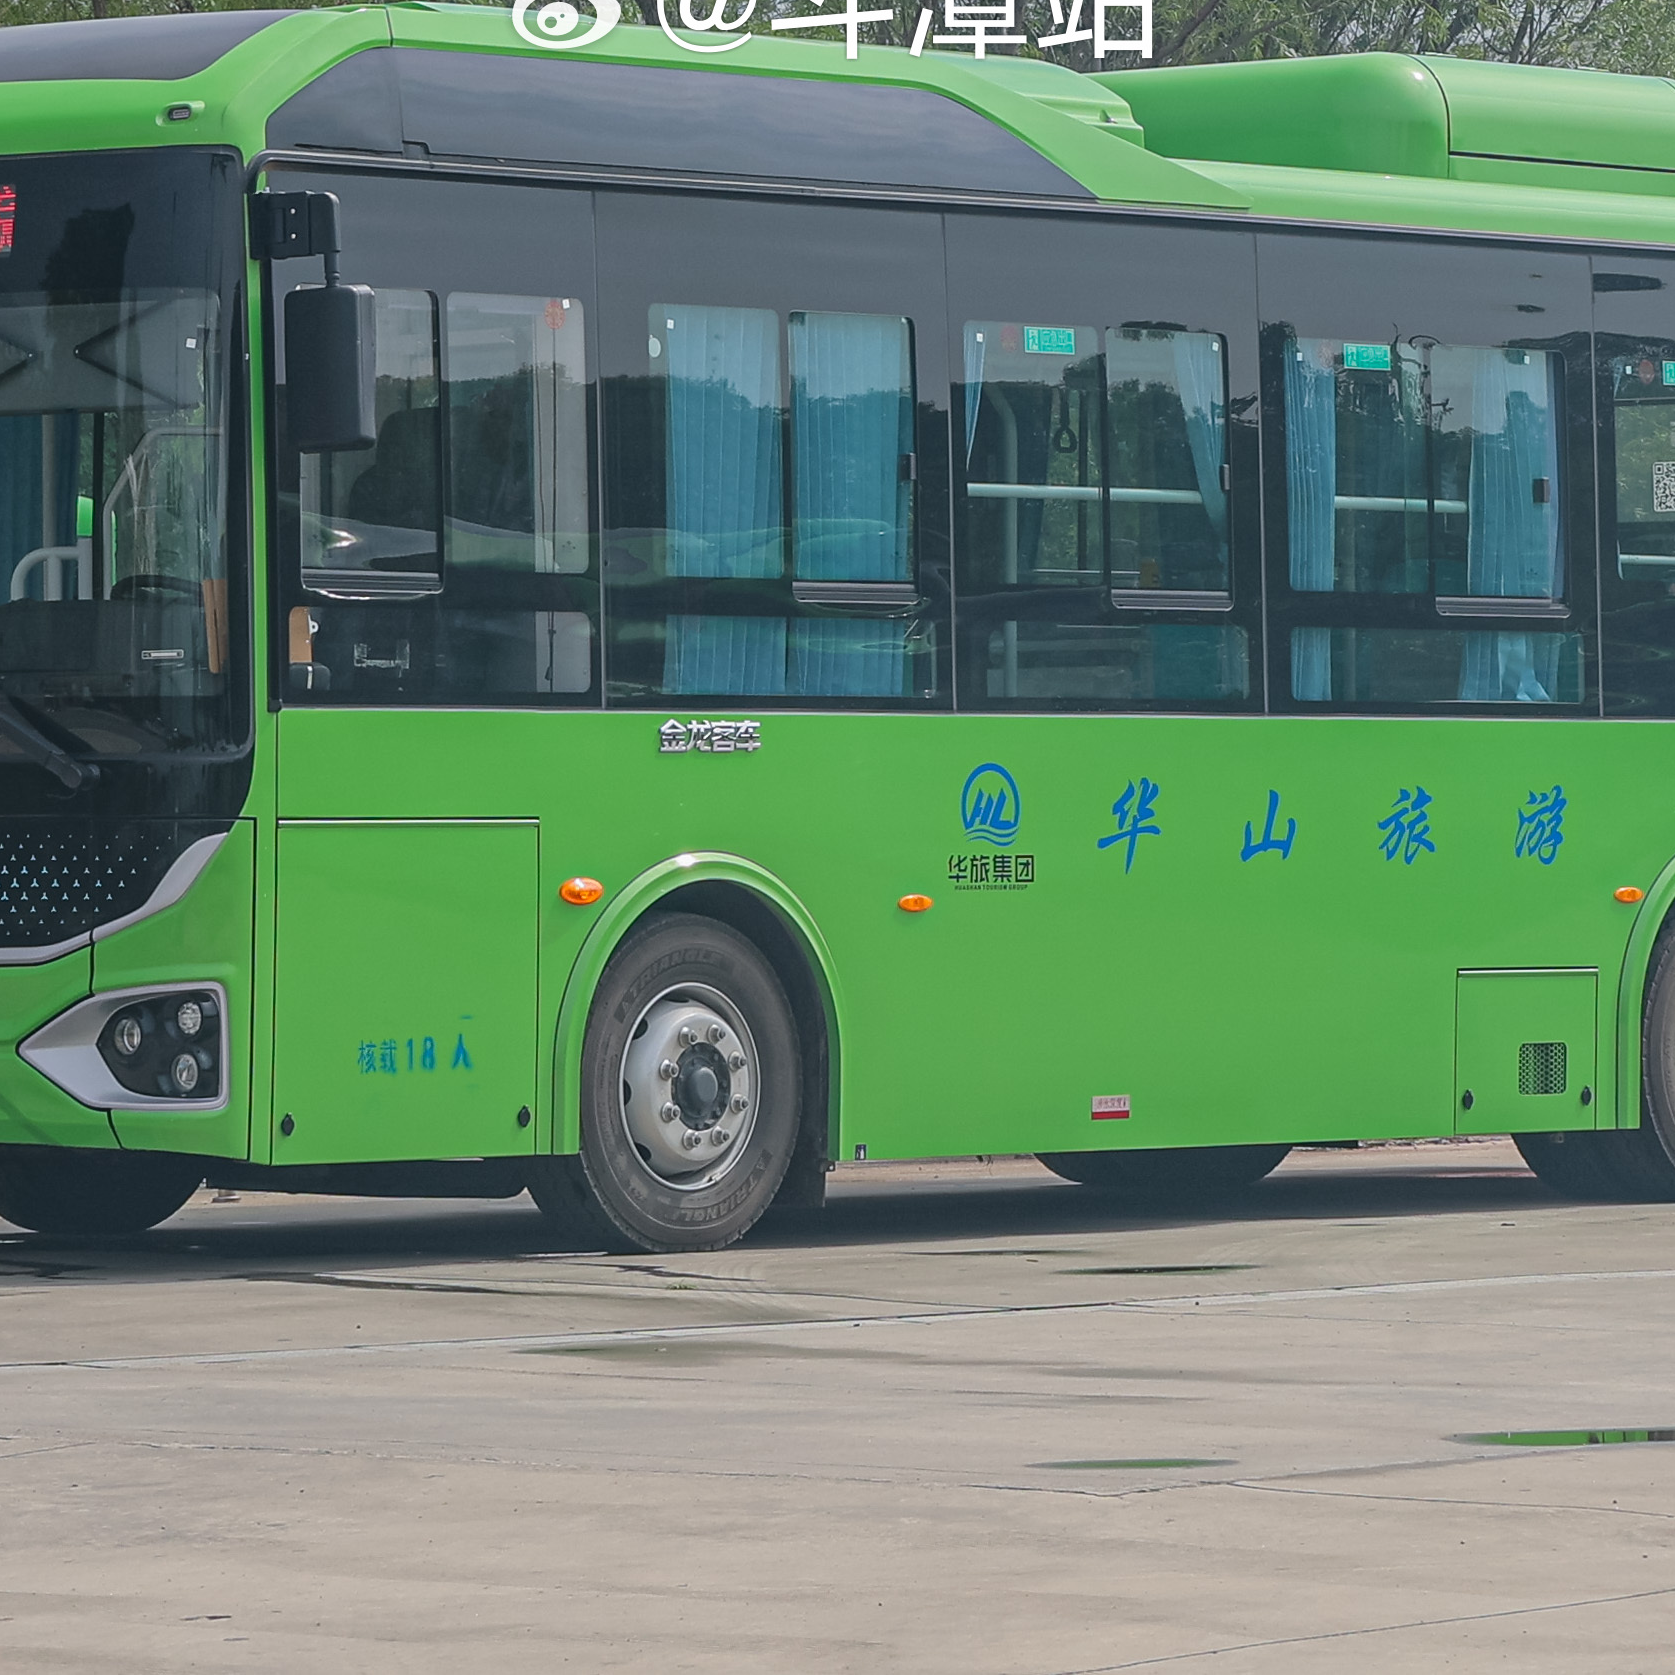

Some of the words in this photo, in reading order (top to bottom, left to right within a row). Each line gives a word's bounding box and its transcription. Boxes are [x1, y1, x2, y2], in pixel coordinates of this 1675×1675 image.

[659, 718, 762, 753] 金龙客车
[947, 854, 1035, 883] 华旅集团
